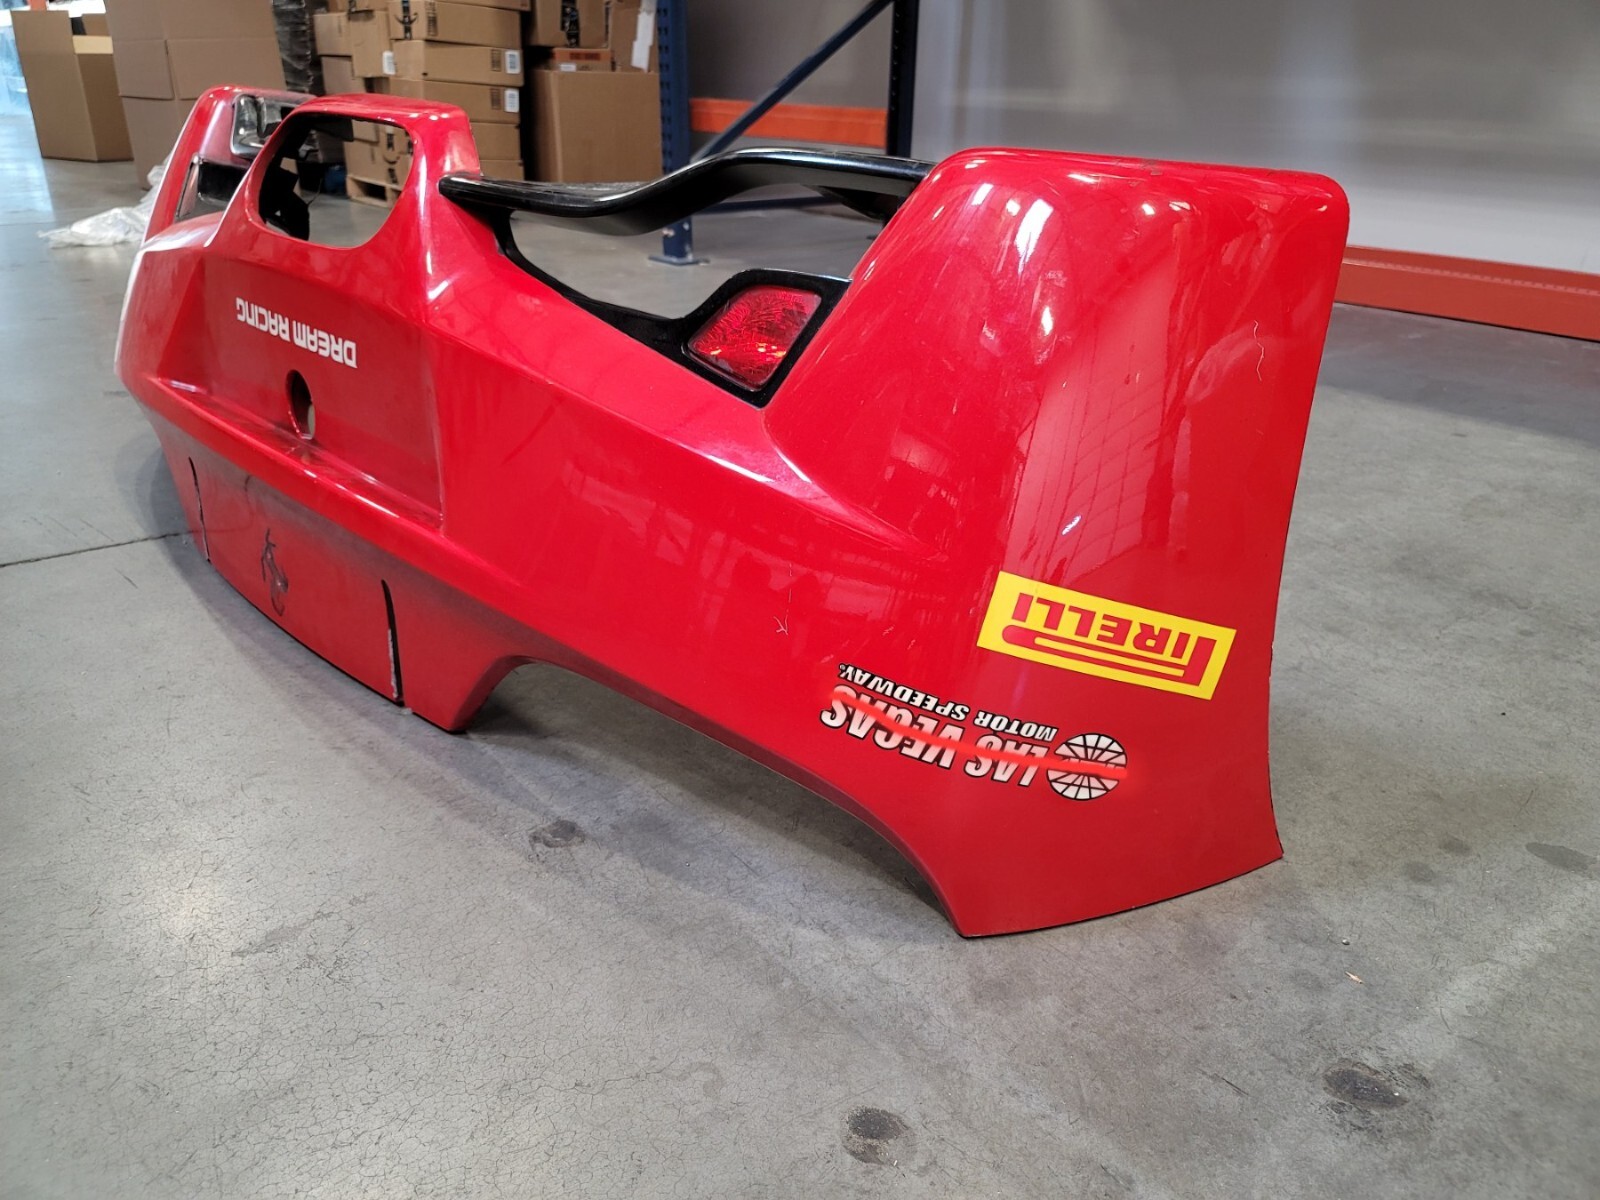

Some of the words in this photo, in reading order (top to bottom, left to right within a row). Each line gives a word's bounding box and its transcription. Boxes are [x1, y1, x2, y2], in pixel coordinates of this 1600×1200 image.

[235, 297, 291, 342] RACING
[292, 320, 358, 369] DREAM
[1001, 592, 1218, 687] PIRELLI
[820, 684, 965, 769] VEGAS
[973, 710, 1059, 742] MOTOR
[964, 734, 1050, 787] LAS
